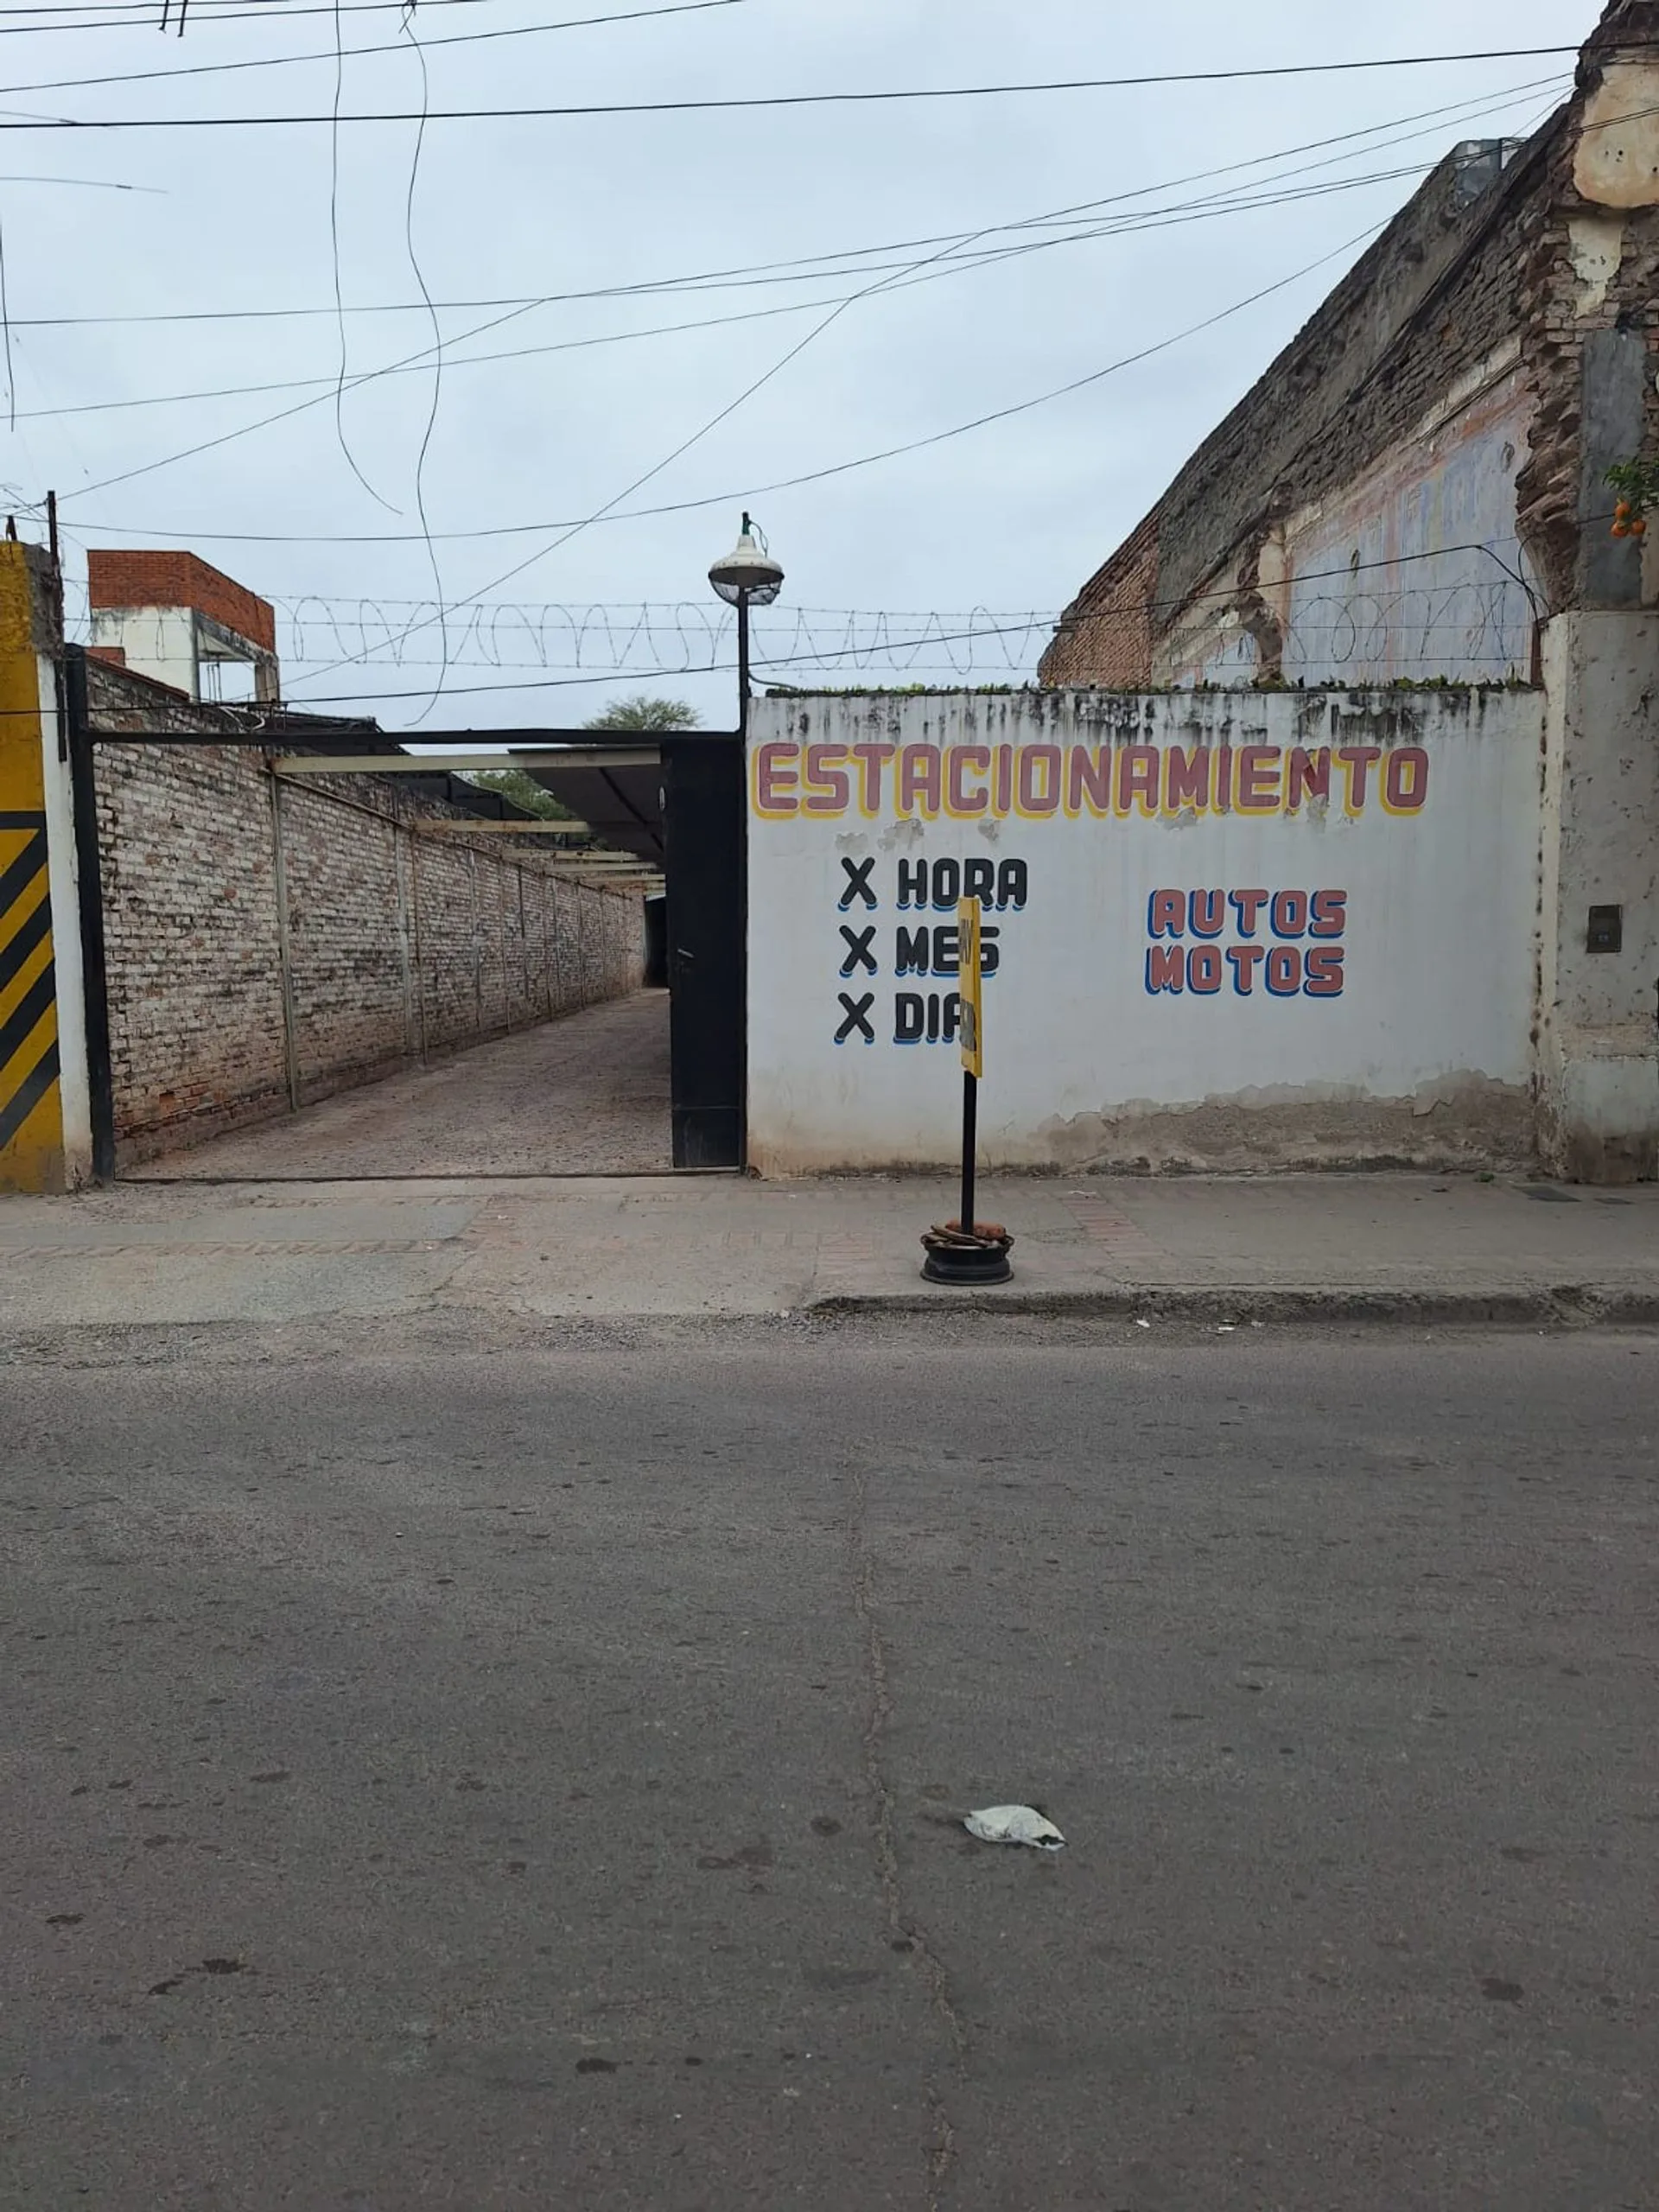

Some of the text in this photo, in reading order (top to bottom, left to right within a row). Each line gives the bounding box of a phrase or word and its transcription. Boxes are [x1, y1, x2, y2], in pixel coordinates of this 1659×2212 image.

[753, 743, 1429, 819] ESTACIONAMIENTO
[836, 857, 1027, 912] X HORA
[1147, 889, 1347, 939] AUTOS
[838, 925, 877, 977] X
[1145, 945, 1344, 997] MOTOS
[834, 992, 874, 1045] X
